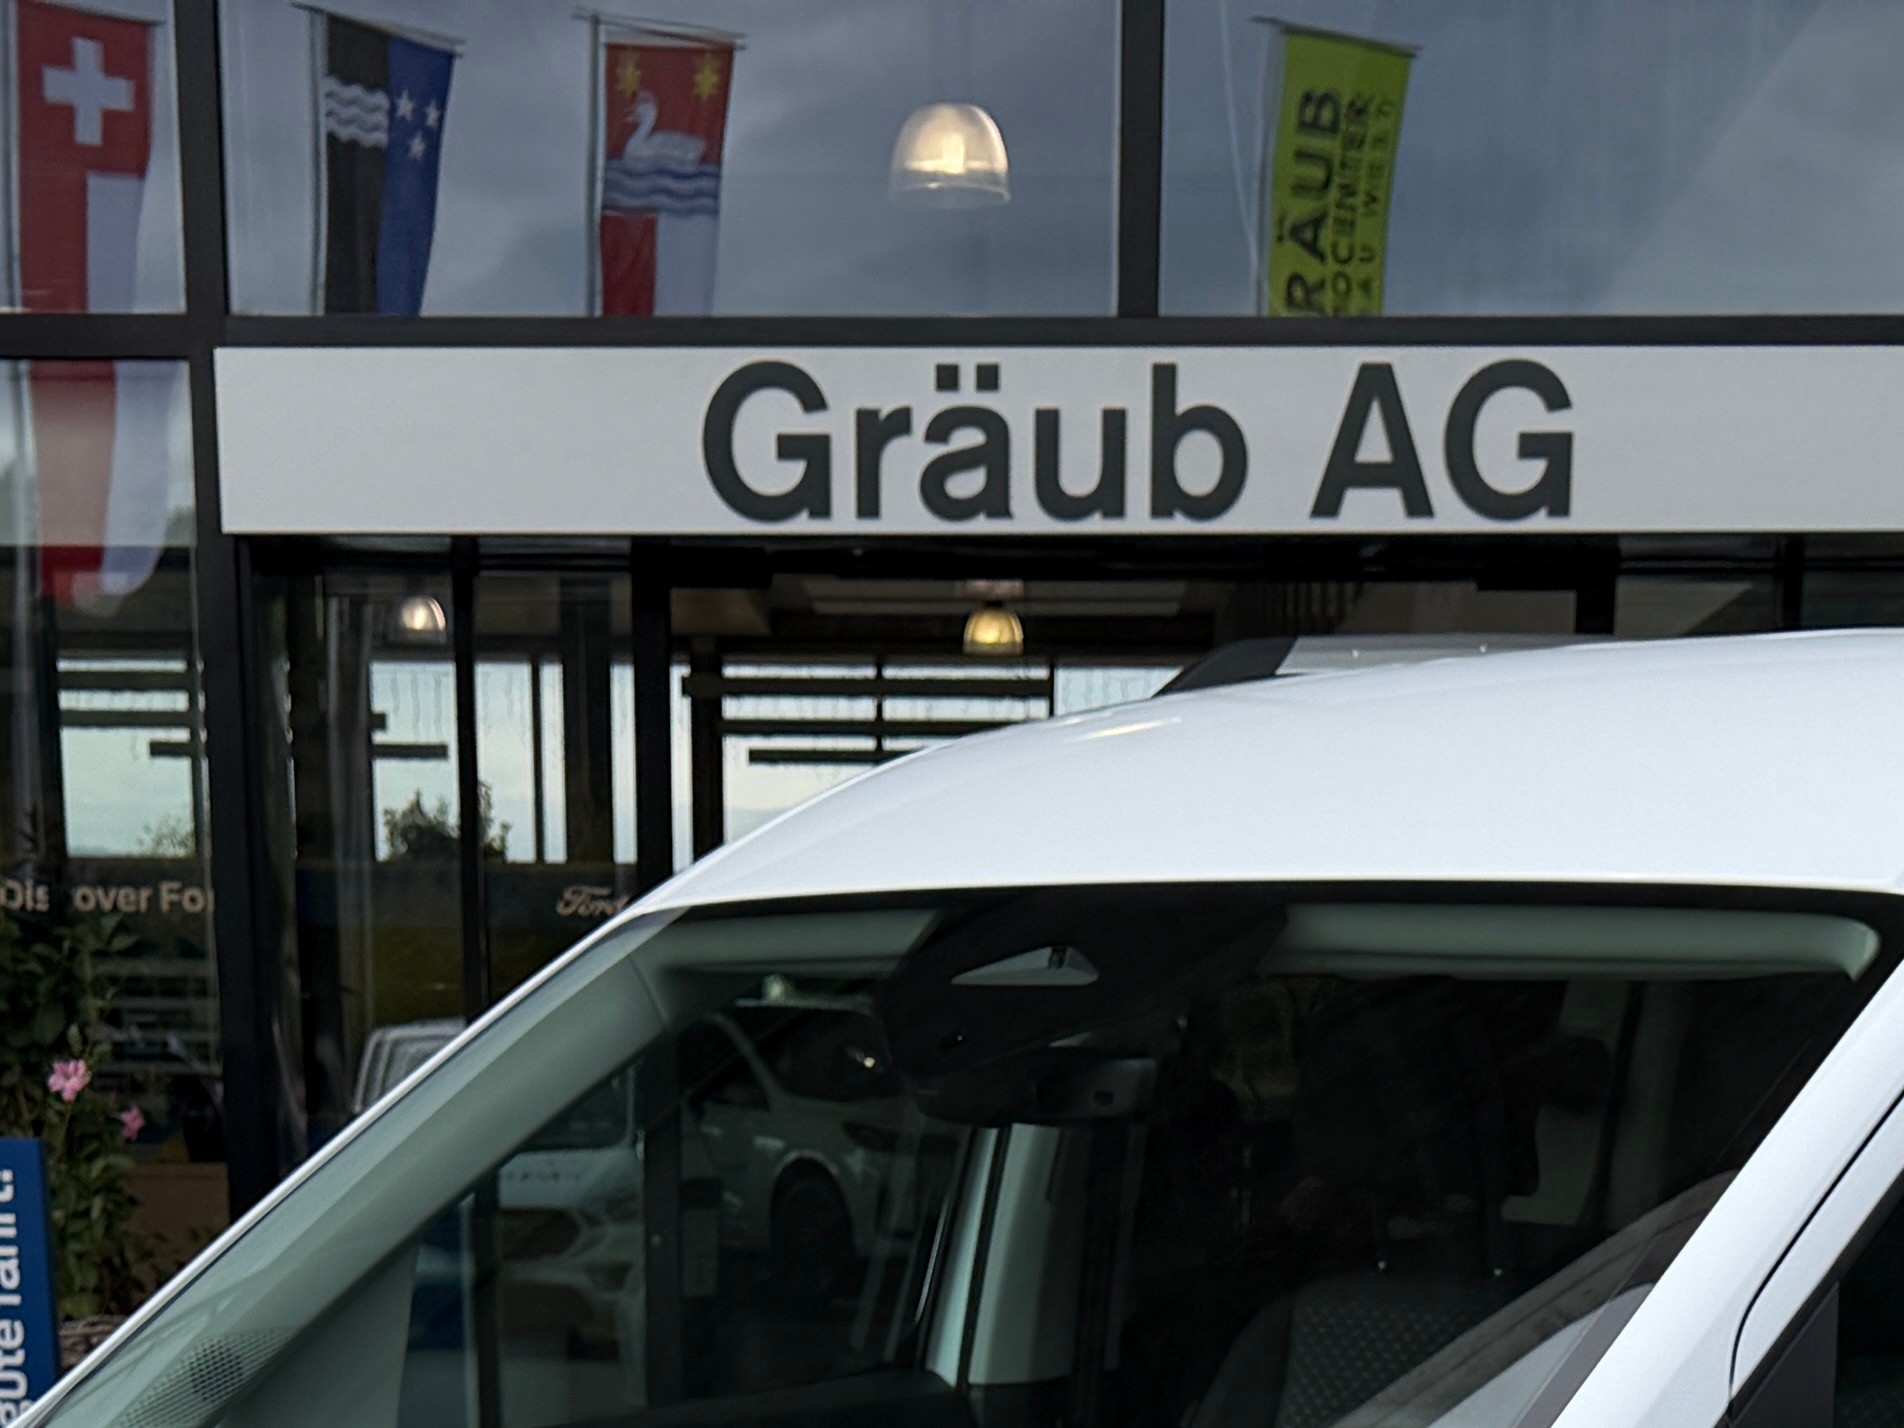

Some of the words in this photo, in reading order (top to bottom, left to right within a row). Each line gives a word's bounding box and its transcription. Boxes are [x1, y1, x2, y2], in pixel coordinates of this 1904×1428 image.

[1276, 88, 1342, 313] RÄUB
[701, 358, 1249, 523] Gräub
[1308, 358, 1574, 523] AG
